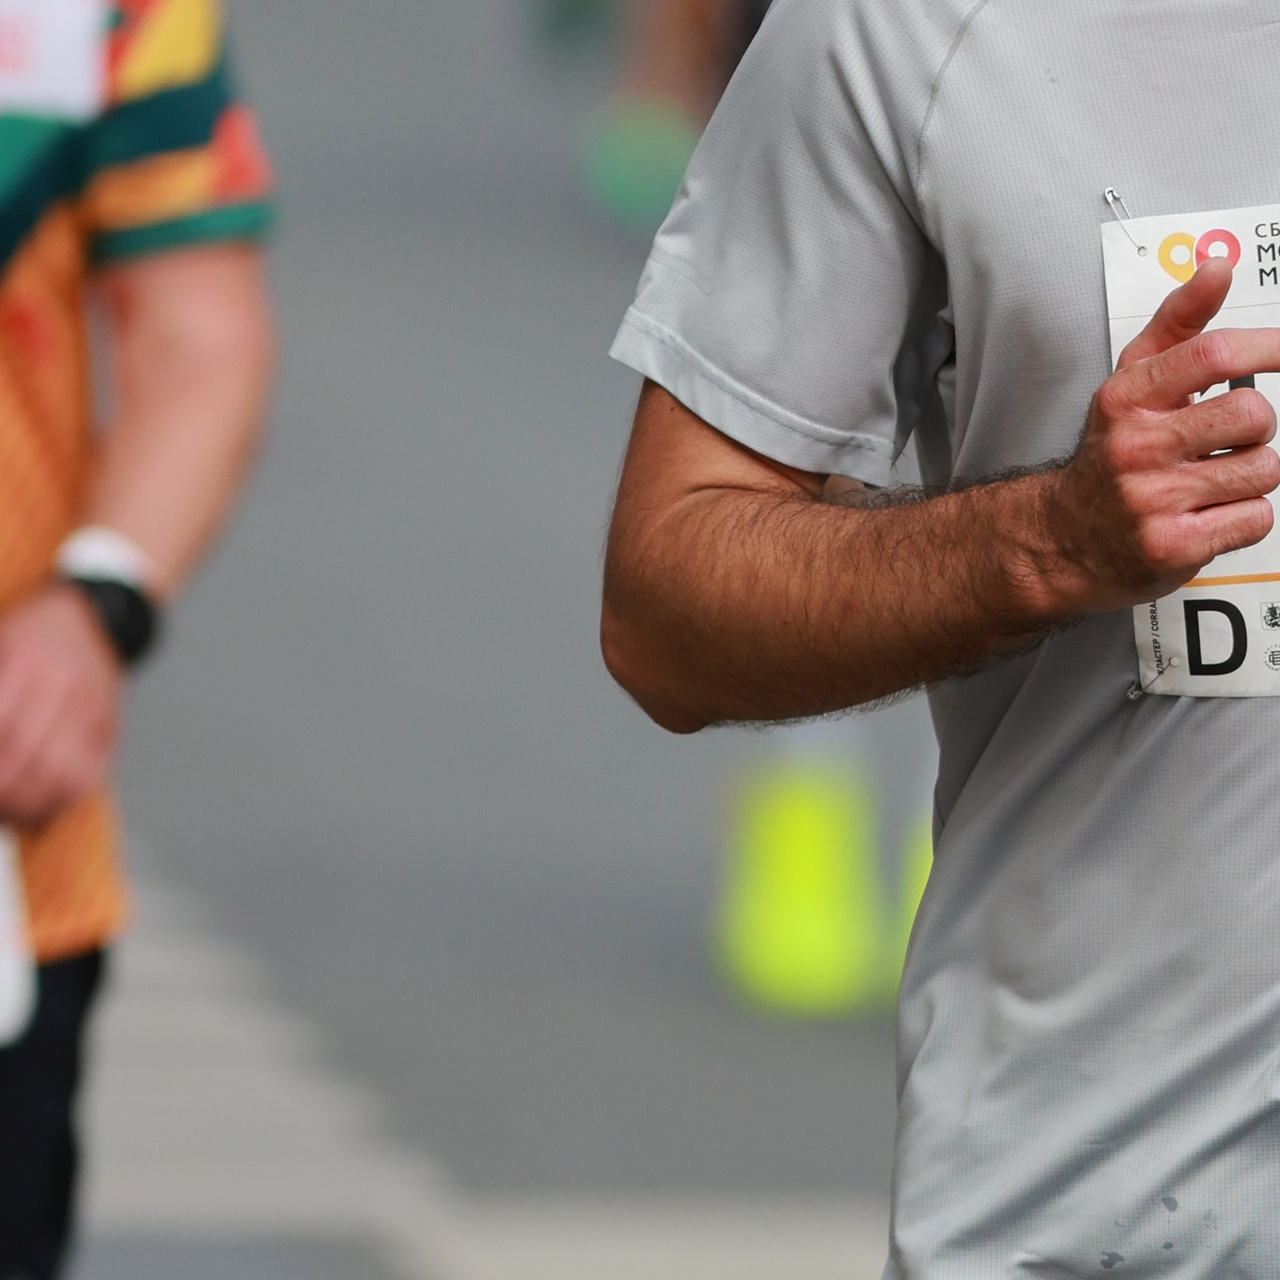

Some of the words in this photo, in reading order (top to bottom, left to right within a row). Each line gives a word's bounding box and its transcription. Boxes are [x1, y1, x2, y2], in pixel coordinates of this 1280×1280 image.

[1149, 600, 1159, 632] CORRA
[1183, 598, 1249, 677] D
[1152, 639, 1164, 675] КЛАСТЕР
